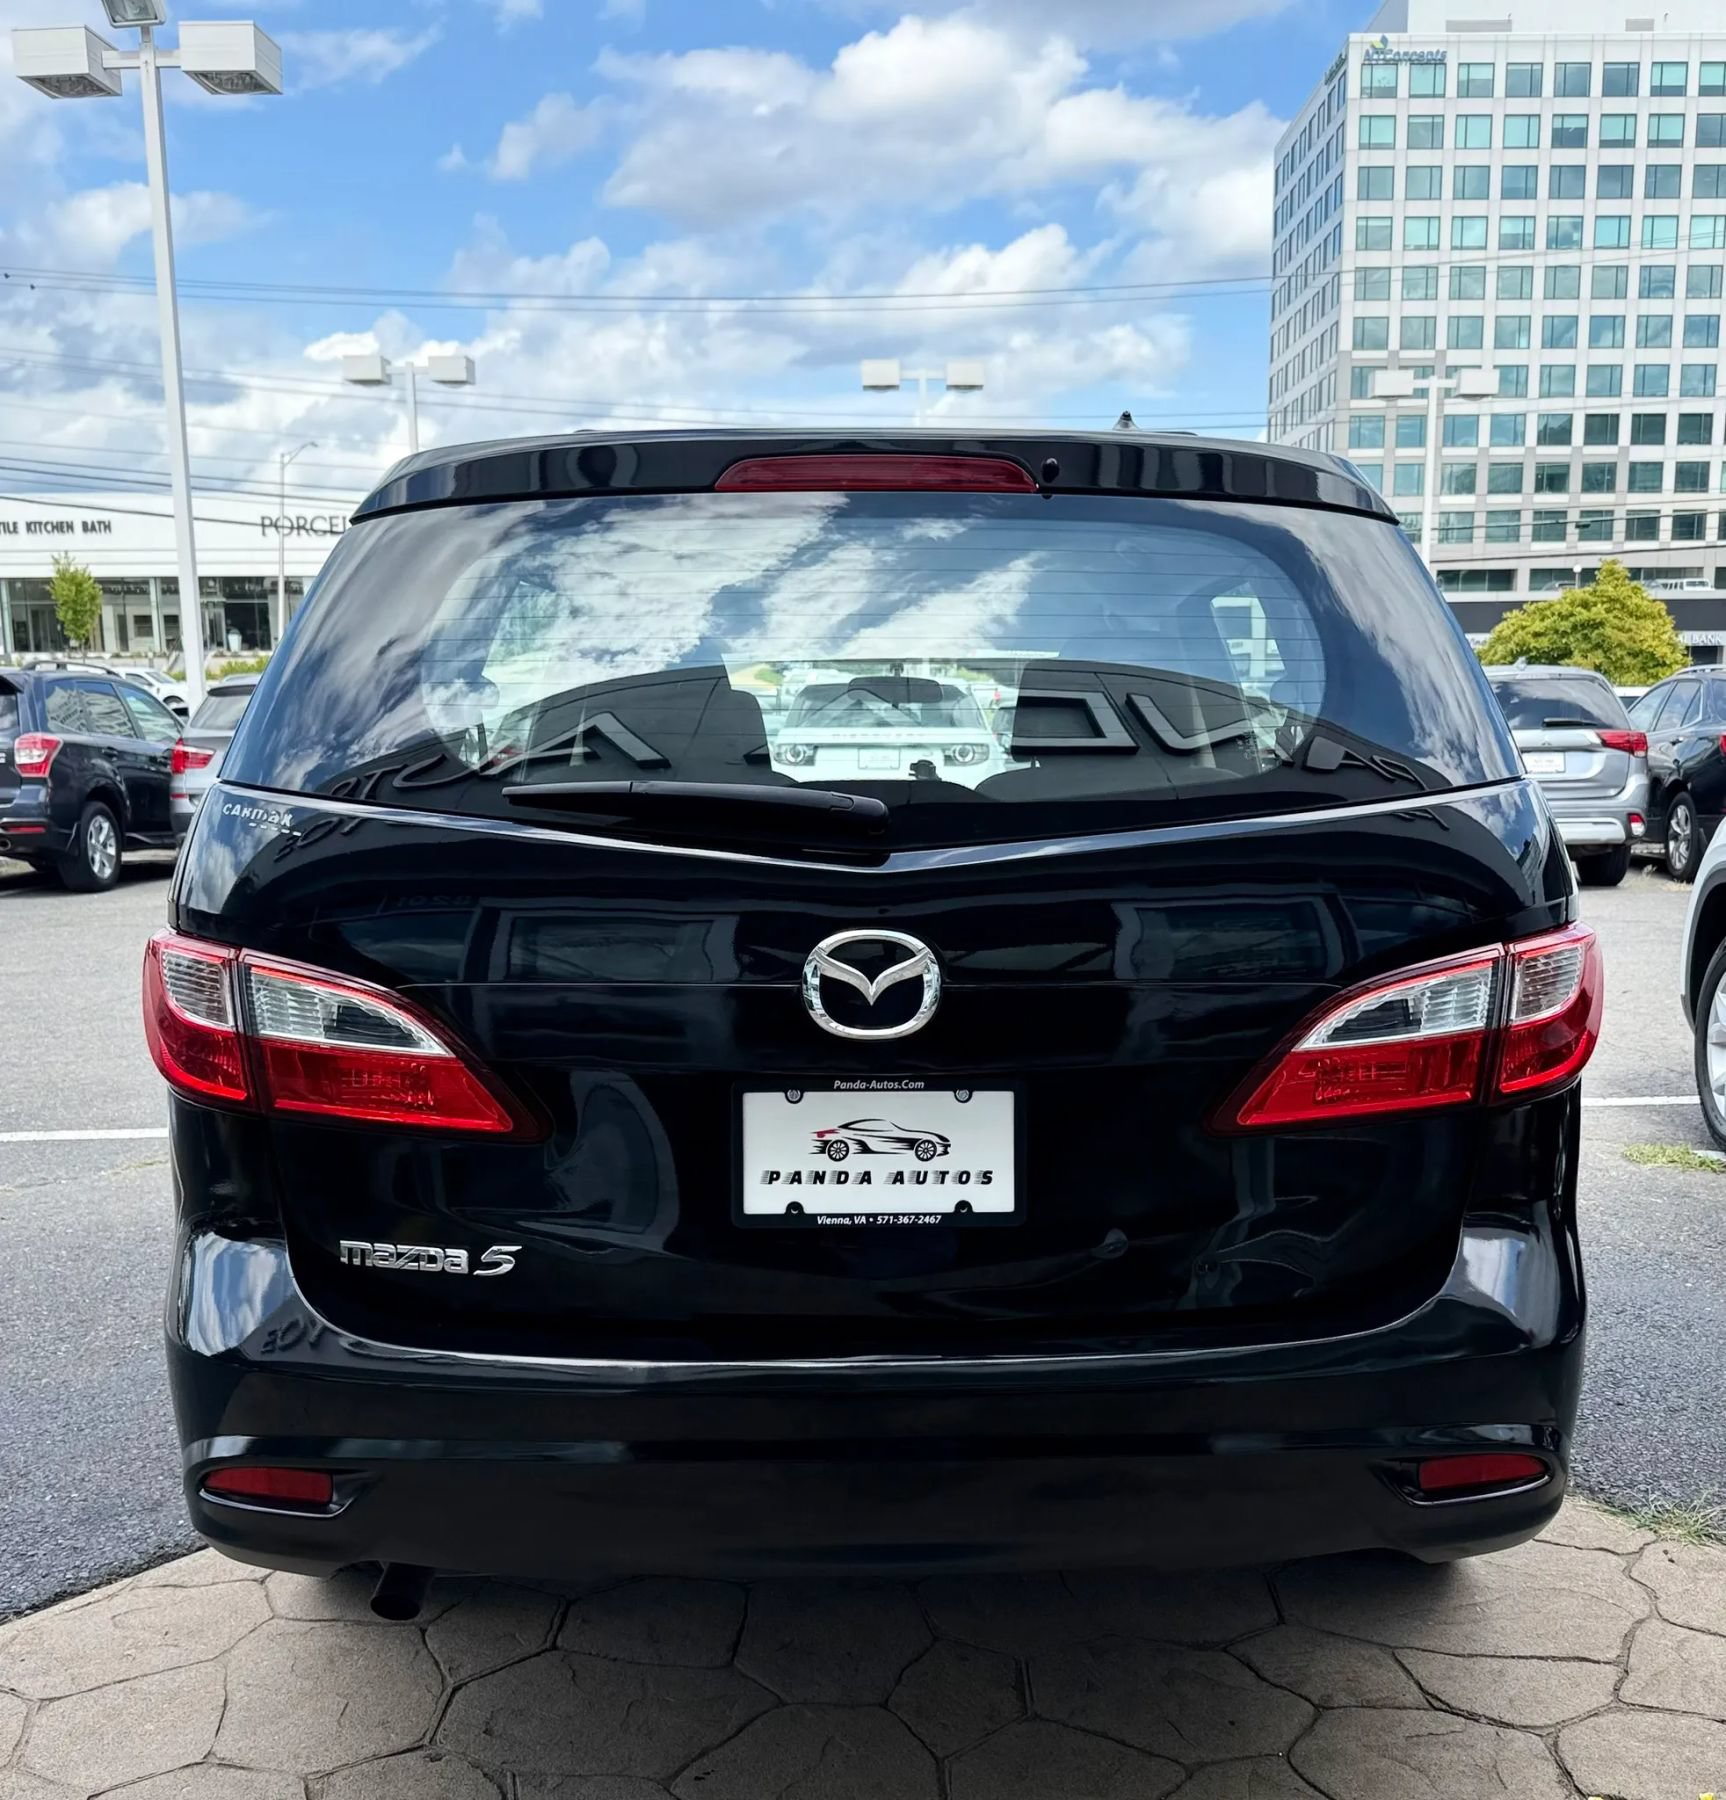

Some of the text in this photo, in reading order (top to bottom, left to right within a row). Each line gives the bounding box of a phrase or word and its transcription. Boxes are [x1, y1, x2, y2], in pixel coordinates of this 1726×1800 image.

[25, 521, 74, 534] KITCHEN
[82, 520, 112, 533] BATH
[1691, 632, 1722, 644] BANK
[833, 1080, 925, 1091] Panda-Autos.Com
[761, 1169, 994, 1185] PANDA AUTOS
[817, 1215, 942, 1225] Vienna, VA 571-367-2467
[473, 1245, 523, 1276] 5
